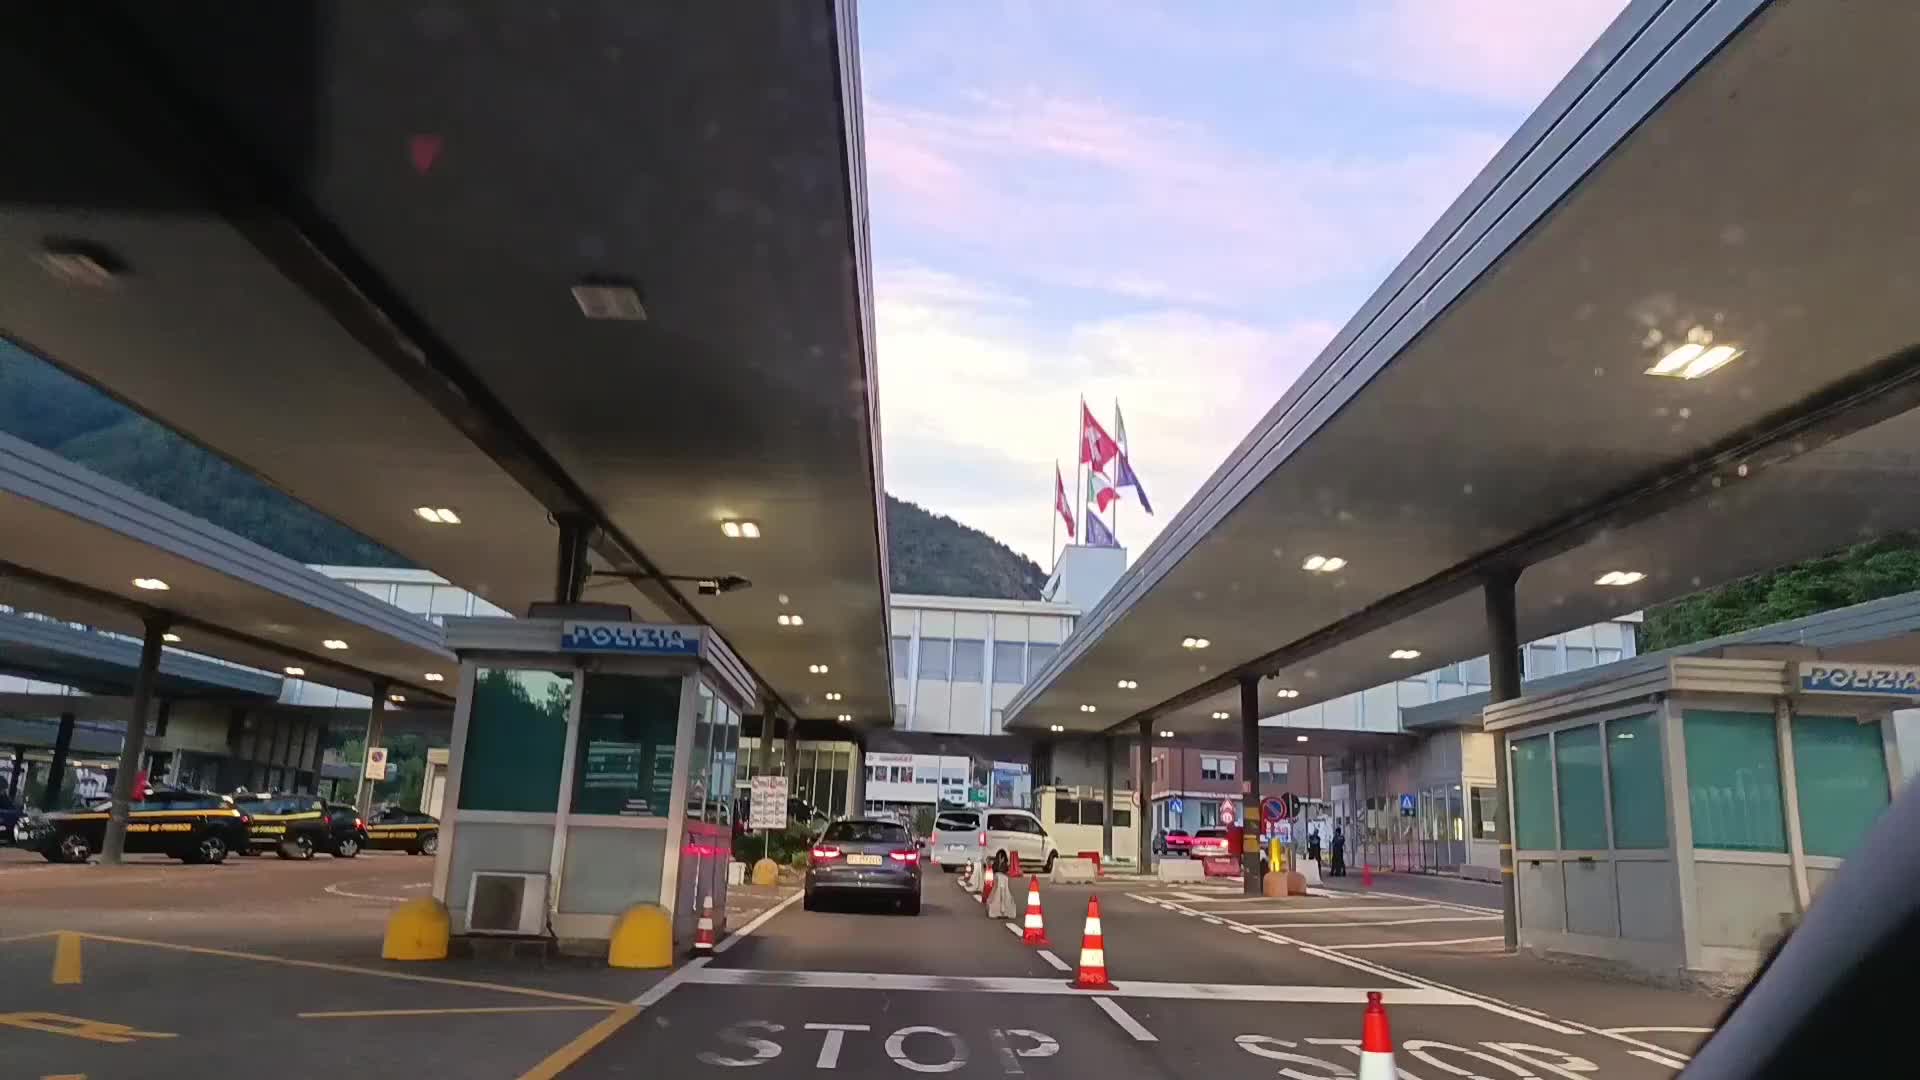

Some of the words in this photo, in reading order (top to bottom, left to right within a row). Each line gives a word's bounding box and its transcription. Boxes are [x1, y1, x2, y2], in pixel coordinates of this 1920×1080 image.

[572, 623, 686, 649] POLIZIA
[1810, 666, 1920, 690] POLIZIA
[696, 1019, 1061, 1074] STOP
